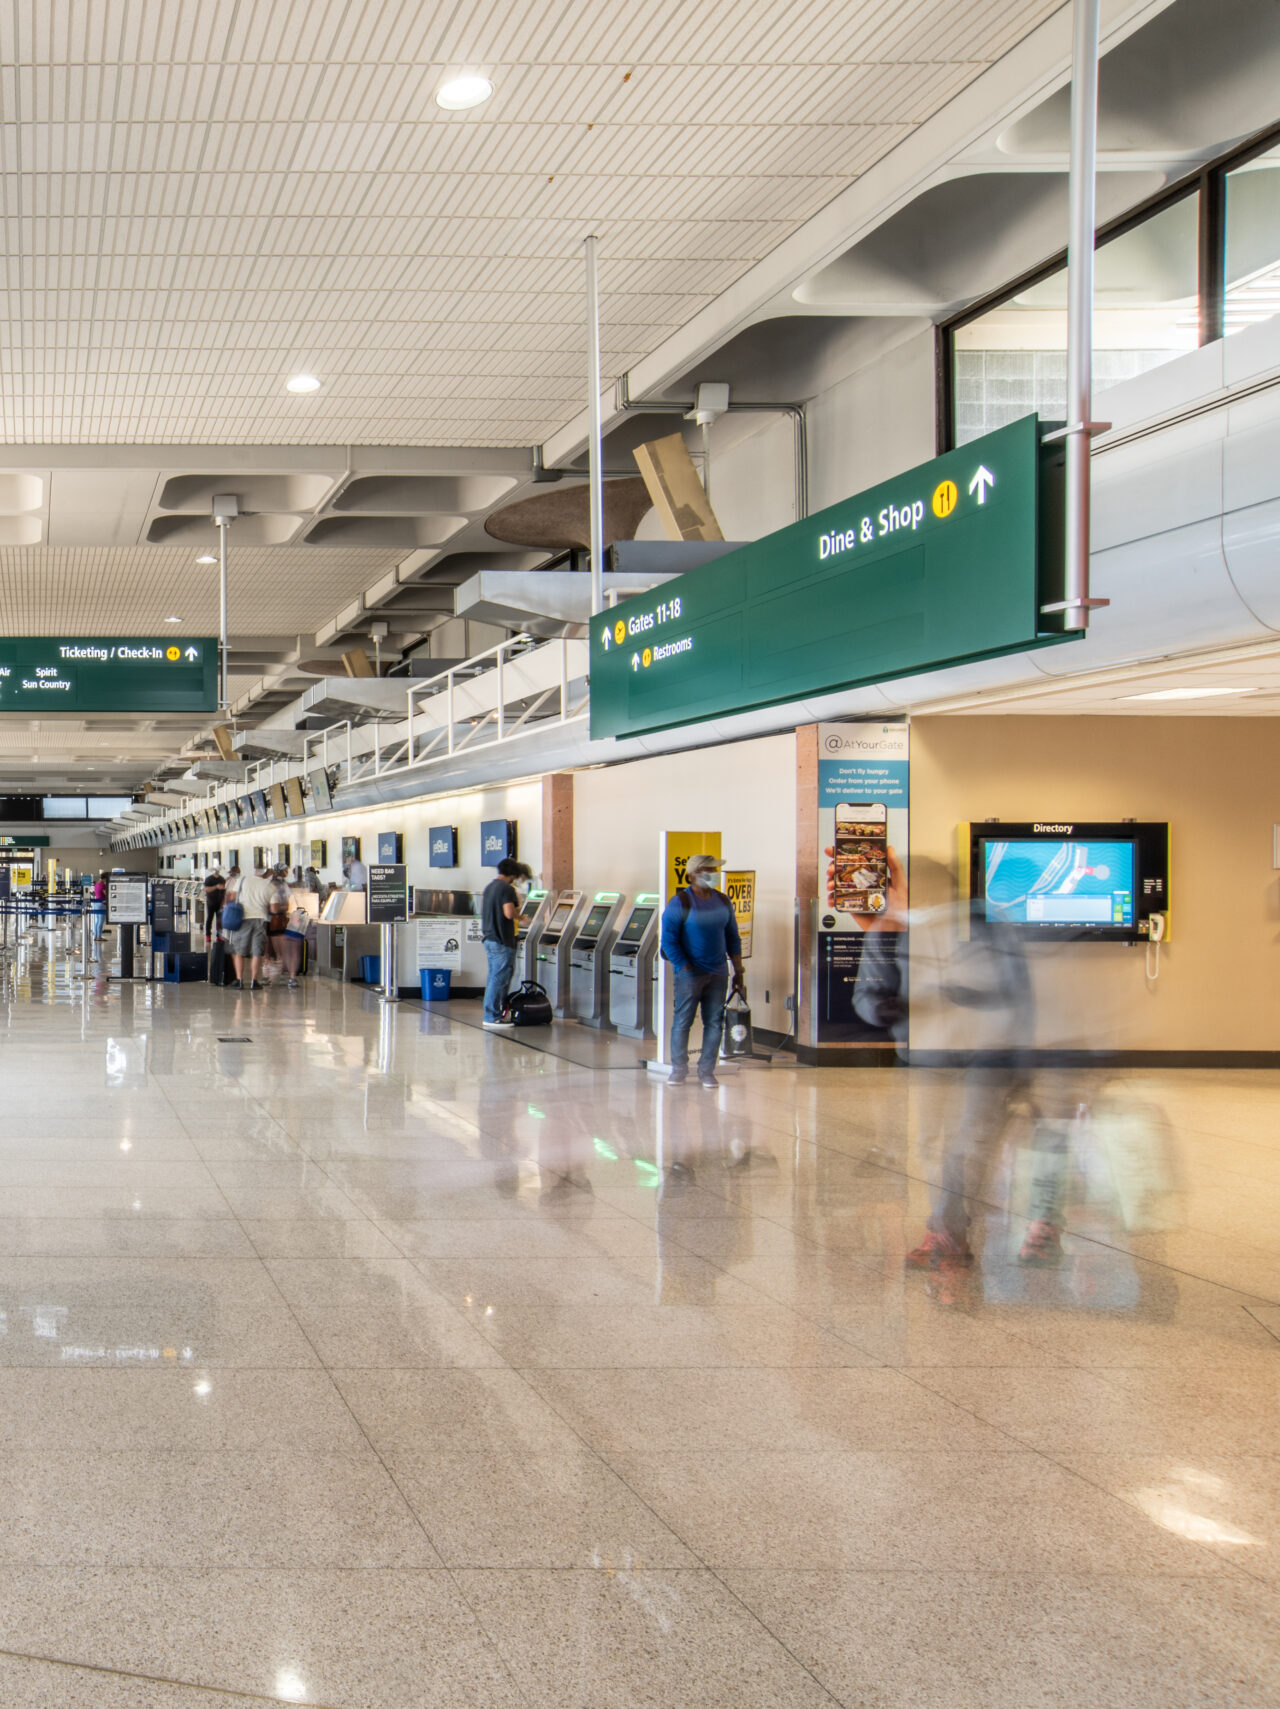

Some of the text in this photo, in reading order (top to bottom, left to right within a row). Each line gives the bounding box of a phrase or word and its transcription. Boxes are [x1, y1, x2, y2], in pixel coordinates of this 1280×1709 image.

[819, 500, 924, 560] Dine & Shop
[628, 597, 681, 636] Gates 11-18
[59, 646, 163, 661] Ticketing / Check-In
[653, 637, 692, 661] Restrooms
[35, 667, 58, 679] Spirit
[22, 680, 71, 691] Sun Country
[1033, 823, 1073, 835] Directory
[727, 884, 752, 900] OVER
[738, 901, 751, 913] LBS
